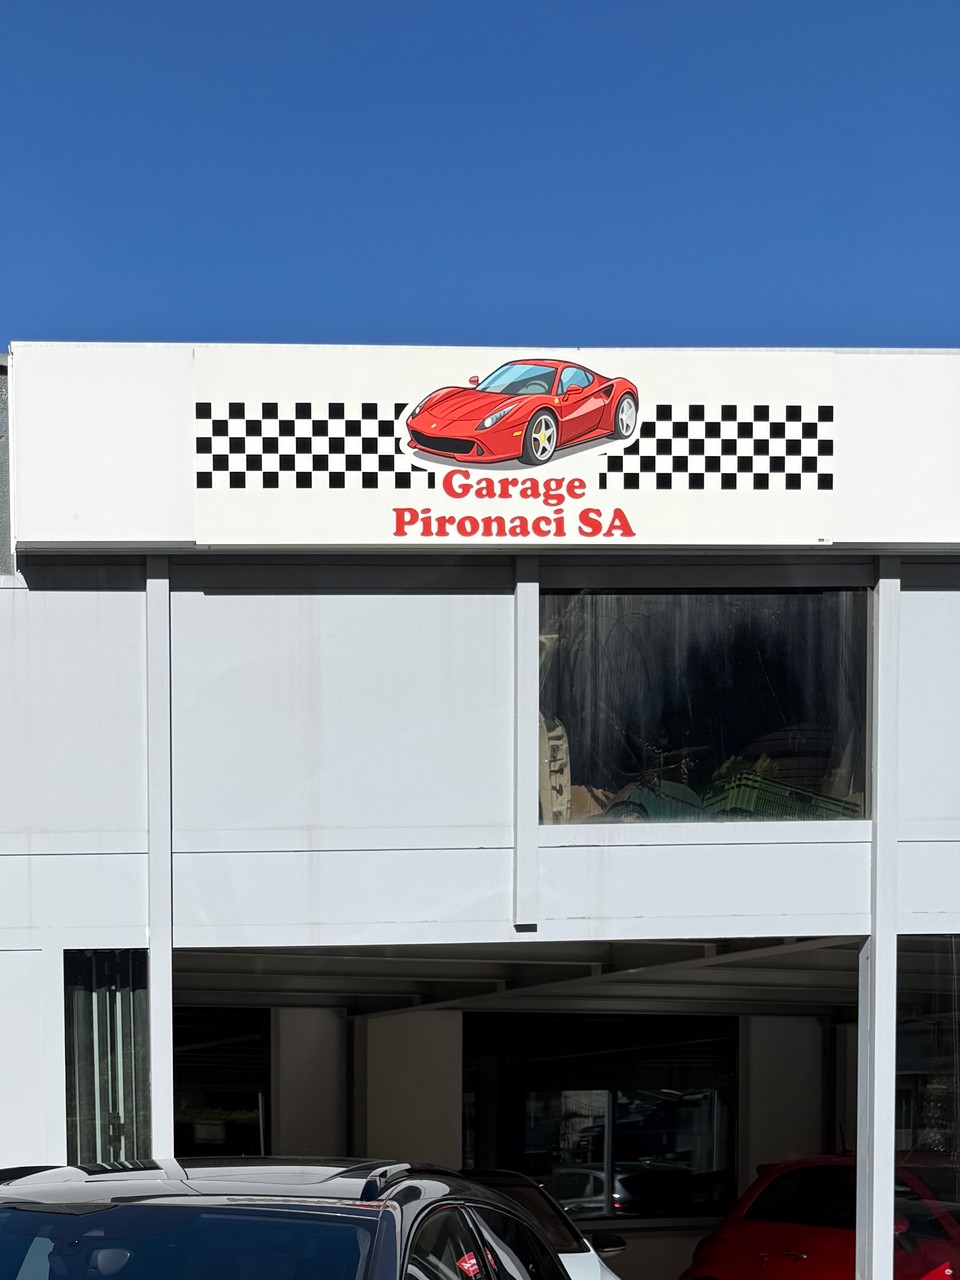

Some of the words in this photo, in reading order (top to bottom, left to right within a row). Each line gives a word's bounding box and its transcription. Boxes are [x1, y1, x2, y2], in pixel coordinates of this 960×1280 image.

[442, 469, 587, 507] Garage
[392, 508, 567, 537] Pironaci
[578, 508, 636, 537] SA
